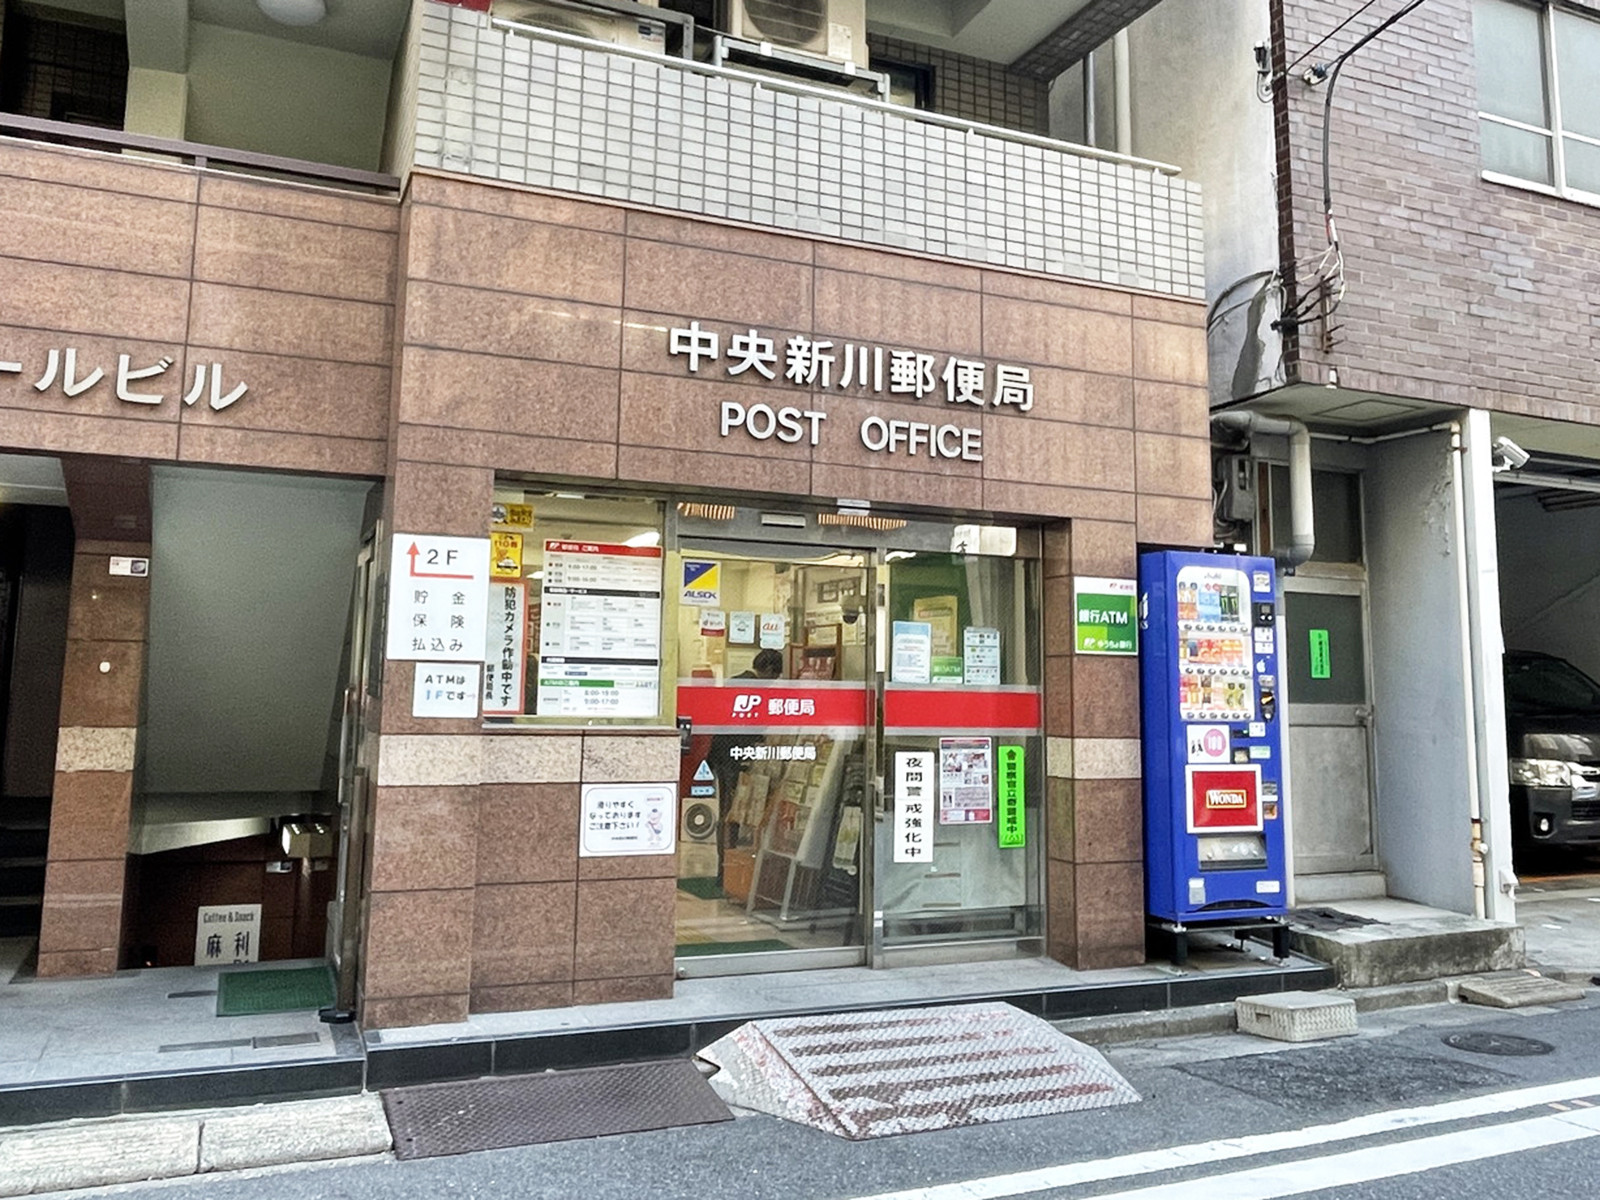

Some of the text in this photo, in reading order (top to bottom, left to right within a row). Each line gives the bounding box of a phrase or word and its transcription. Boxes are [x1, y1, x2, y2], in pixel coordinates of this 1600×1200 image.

[669, 321, 1034, 412] 中央新川郵便局
[720, 400, 984, 462] POST OFFICE
[426, 549, 458, 565] 2F
[413, 589, 465, 605] 貯金
[684, 590, 717, 599] ALSOK
[412, 613, 465, 629] 保険
[1078, 609, 1128, 625] 銀行ATM
[411, 637, 463, 652] 払込み
[501, 586, 516, 707] 防犯カメラ作動中です
[425, 674, 466, 685] ATMは
[768, 698, 816, 716] 郵便局
[729, 745, 817, 761] 中央新川郵便局
[1207, 790, 1244, 806] WONDA
[904, 757, 924, 858] 夜間警戒強化中
[203, 912, 227, 923] Coffee
[206, 931, 250, 958] 麻利
